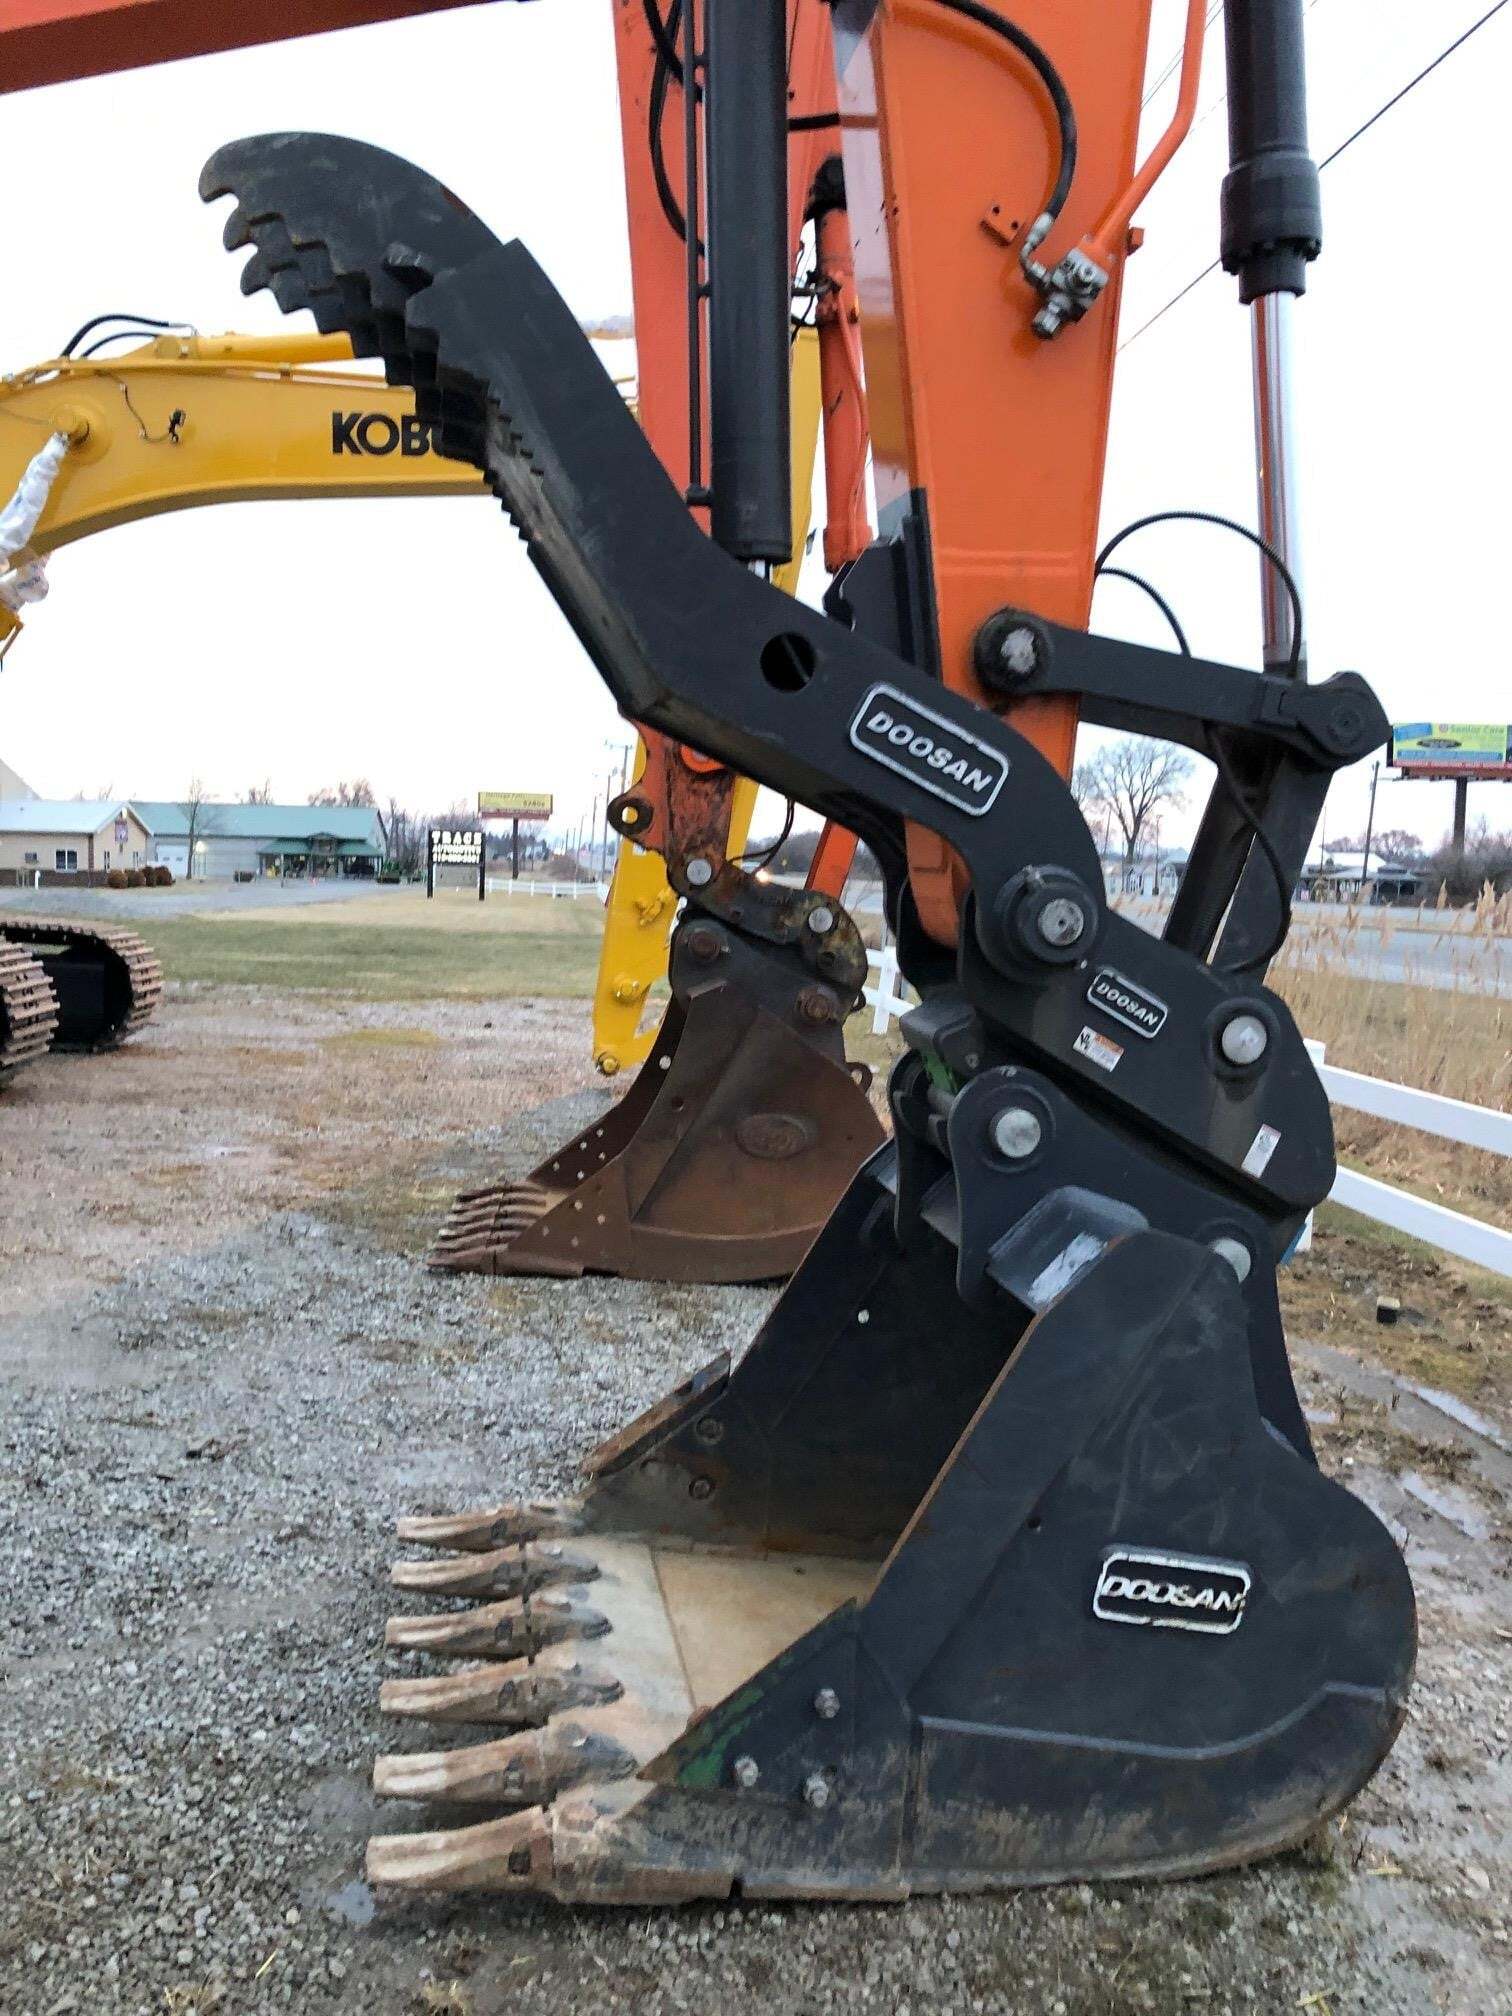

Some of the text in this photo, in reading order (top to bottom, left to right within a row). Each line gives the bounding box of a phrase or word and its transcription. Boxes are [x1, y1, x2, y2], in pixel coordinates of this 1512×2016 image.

[332, 411, 431, 456] KOB
[866, 710, 993, 792] DOOSAN
[1096, 982, 1159, 1026] DOOSAN
[1101, 1575, 1246, 1611] DOOSAN
